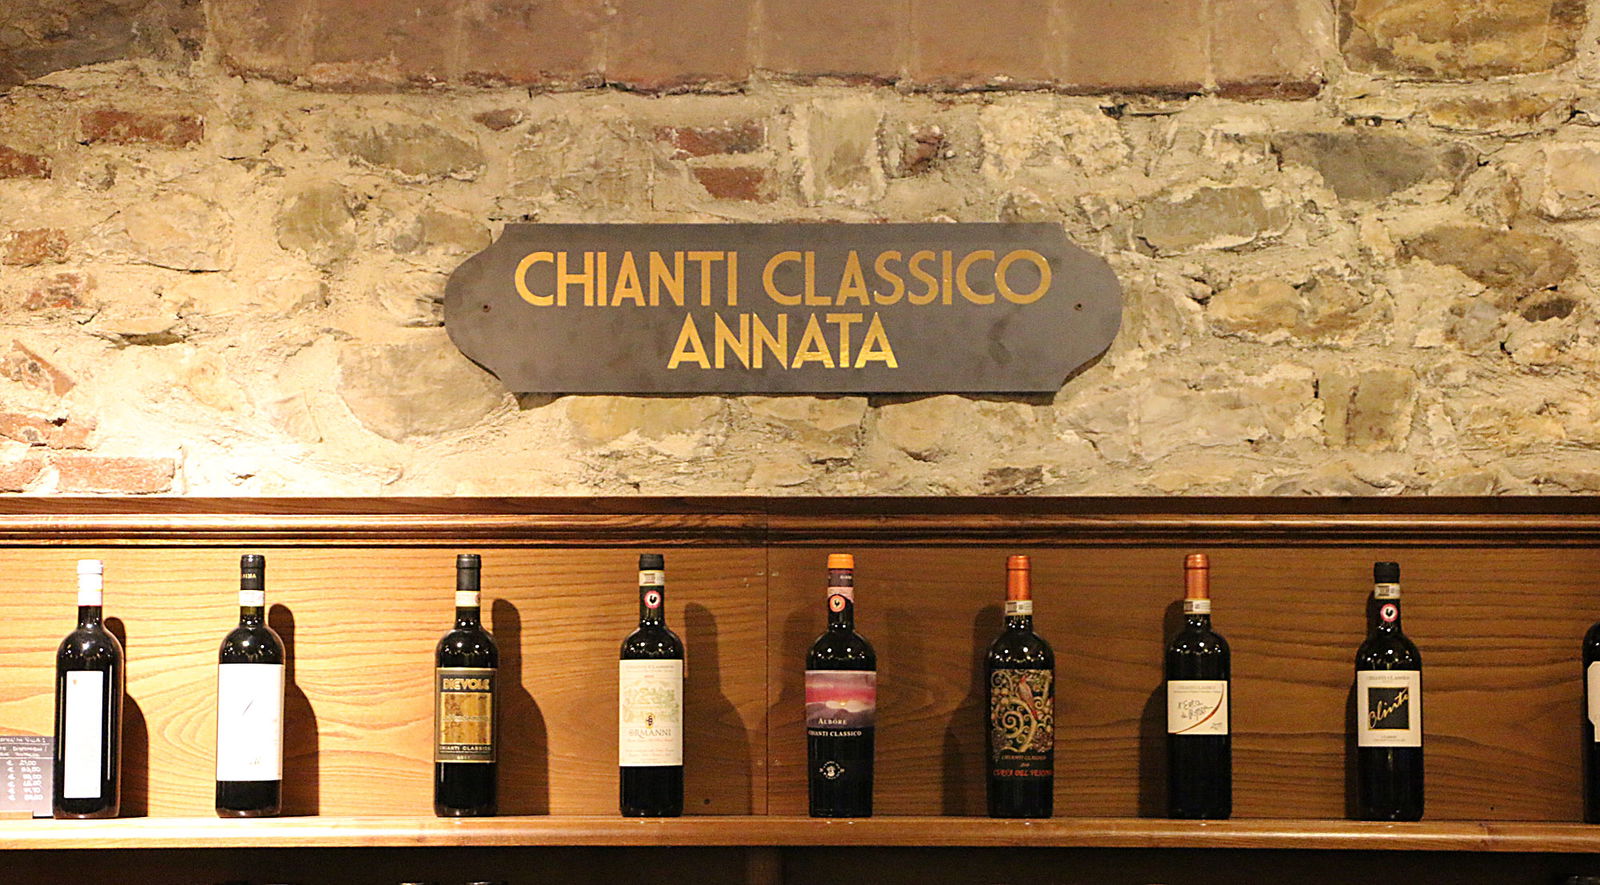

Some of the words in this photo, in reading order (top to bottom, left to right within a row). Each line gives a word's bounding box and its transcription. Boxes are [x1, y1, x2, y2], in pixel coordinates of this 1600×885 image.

[514, 251, 737, 306] CHIANTI
[762, 249, 1051, 306] CLASSICO
[667, 312, 899, 370] ANNATA
